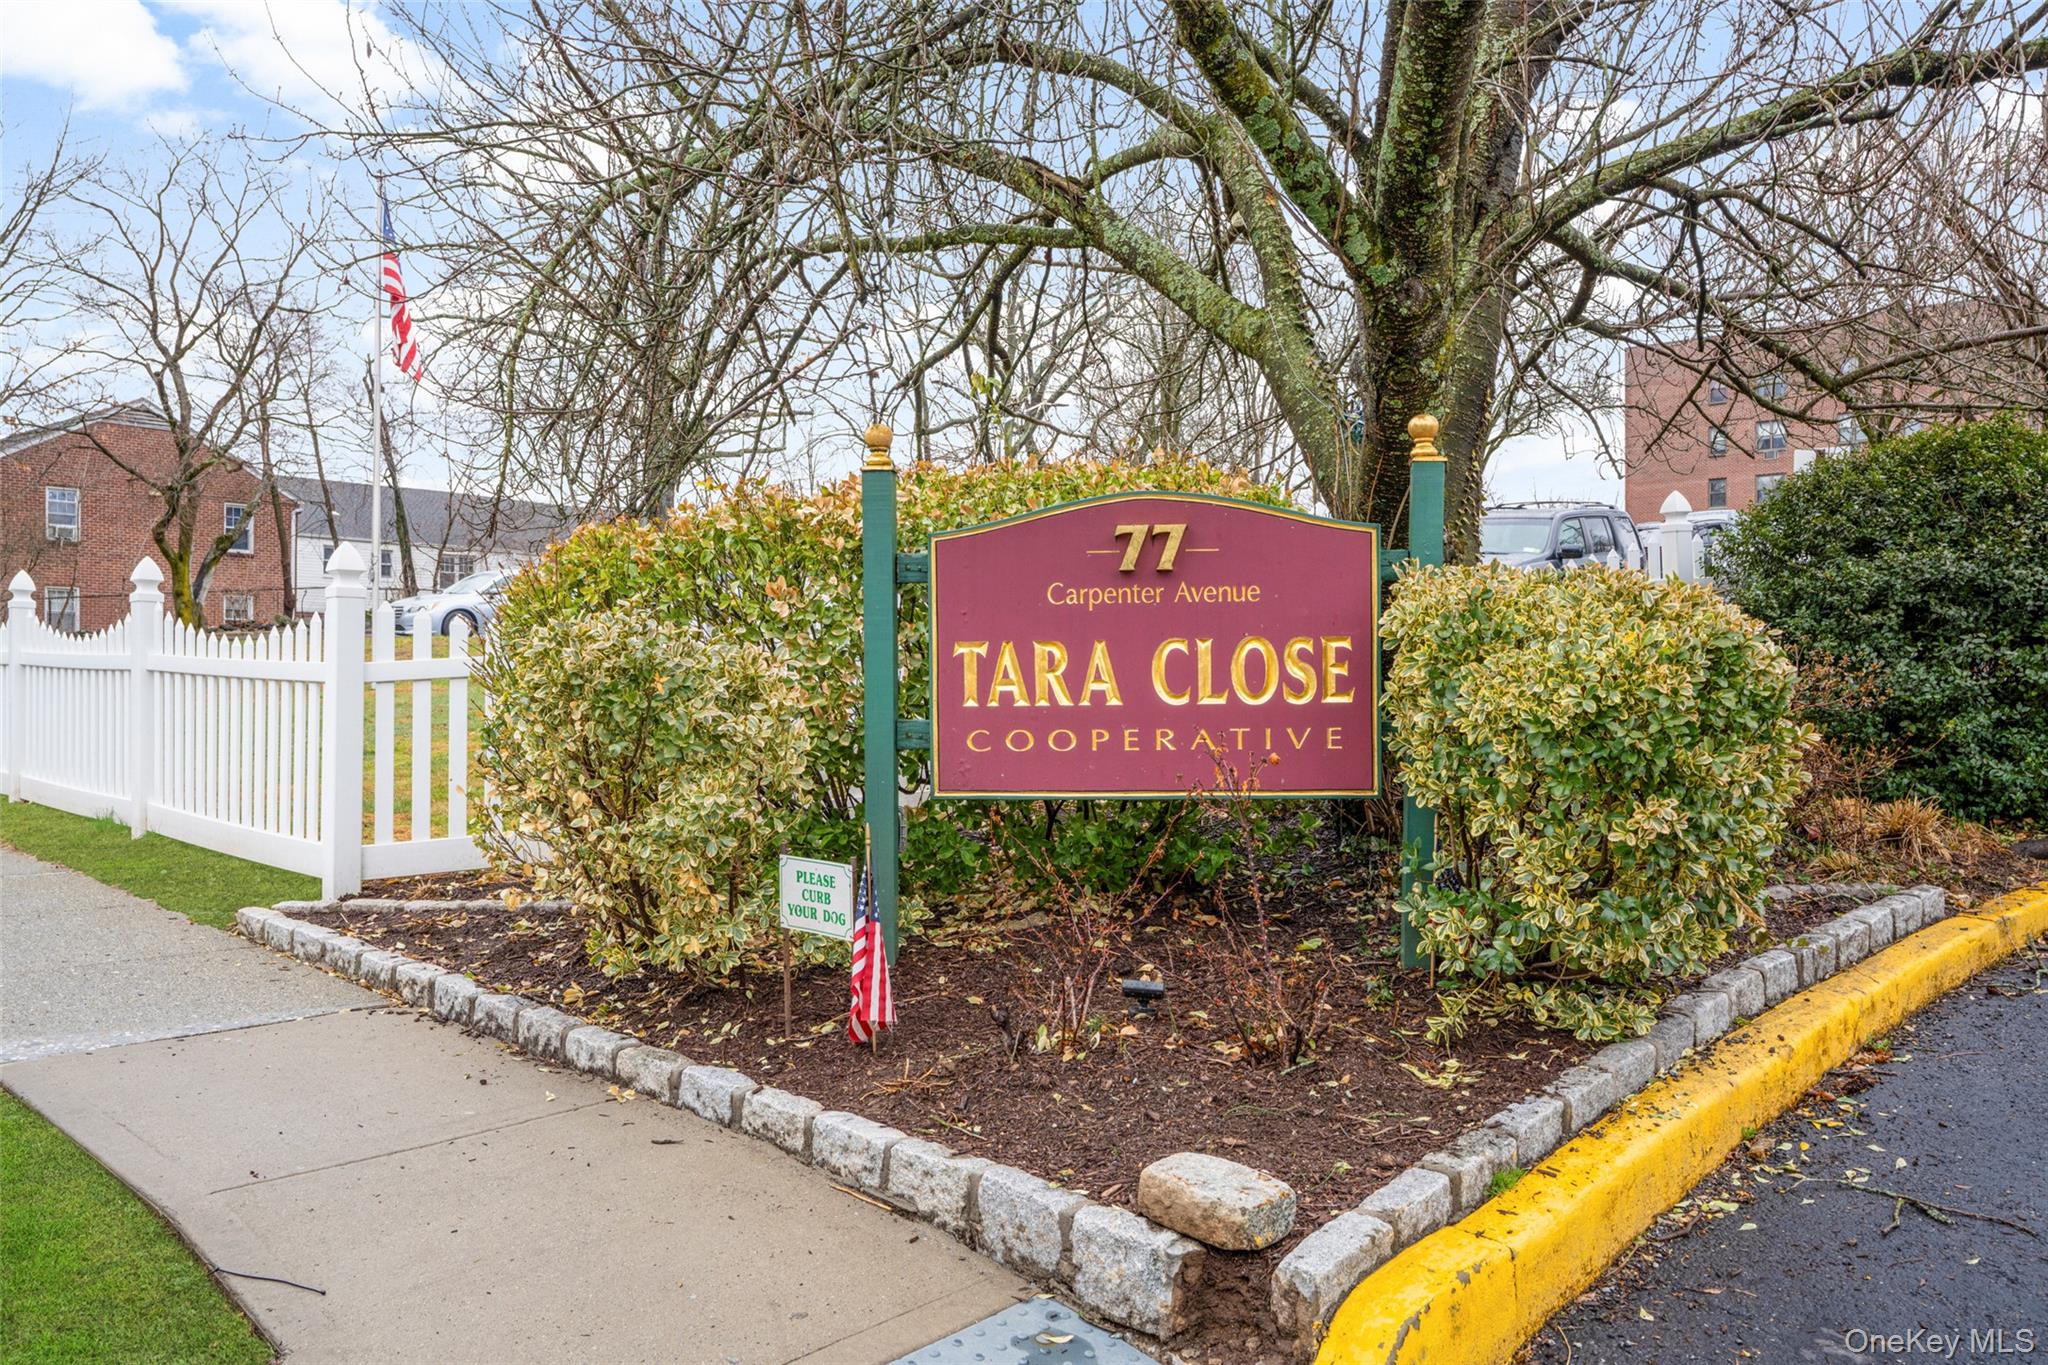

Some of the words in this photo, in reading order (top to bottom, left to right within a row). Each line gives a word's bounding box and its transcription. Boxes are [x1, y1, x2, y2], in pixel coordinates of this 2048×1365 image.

[1114, 523, 1188, 572] 77
[1047, 582, 1165, 611] Carpenter
[1174, 581, 1261, 604] Avenue
[953, 640, 1123, 707] TARA
[1151, 635, 1355, 706] CLOSE
[966, 727, 1343, 752] COOPERATIVE
[796, 870, 836, 889] PLEASE
[802, 888, 831, 905] CURB
[787, 903, 817, 920] YOUR
[823, 909, 846, 926] DOG
